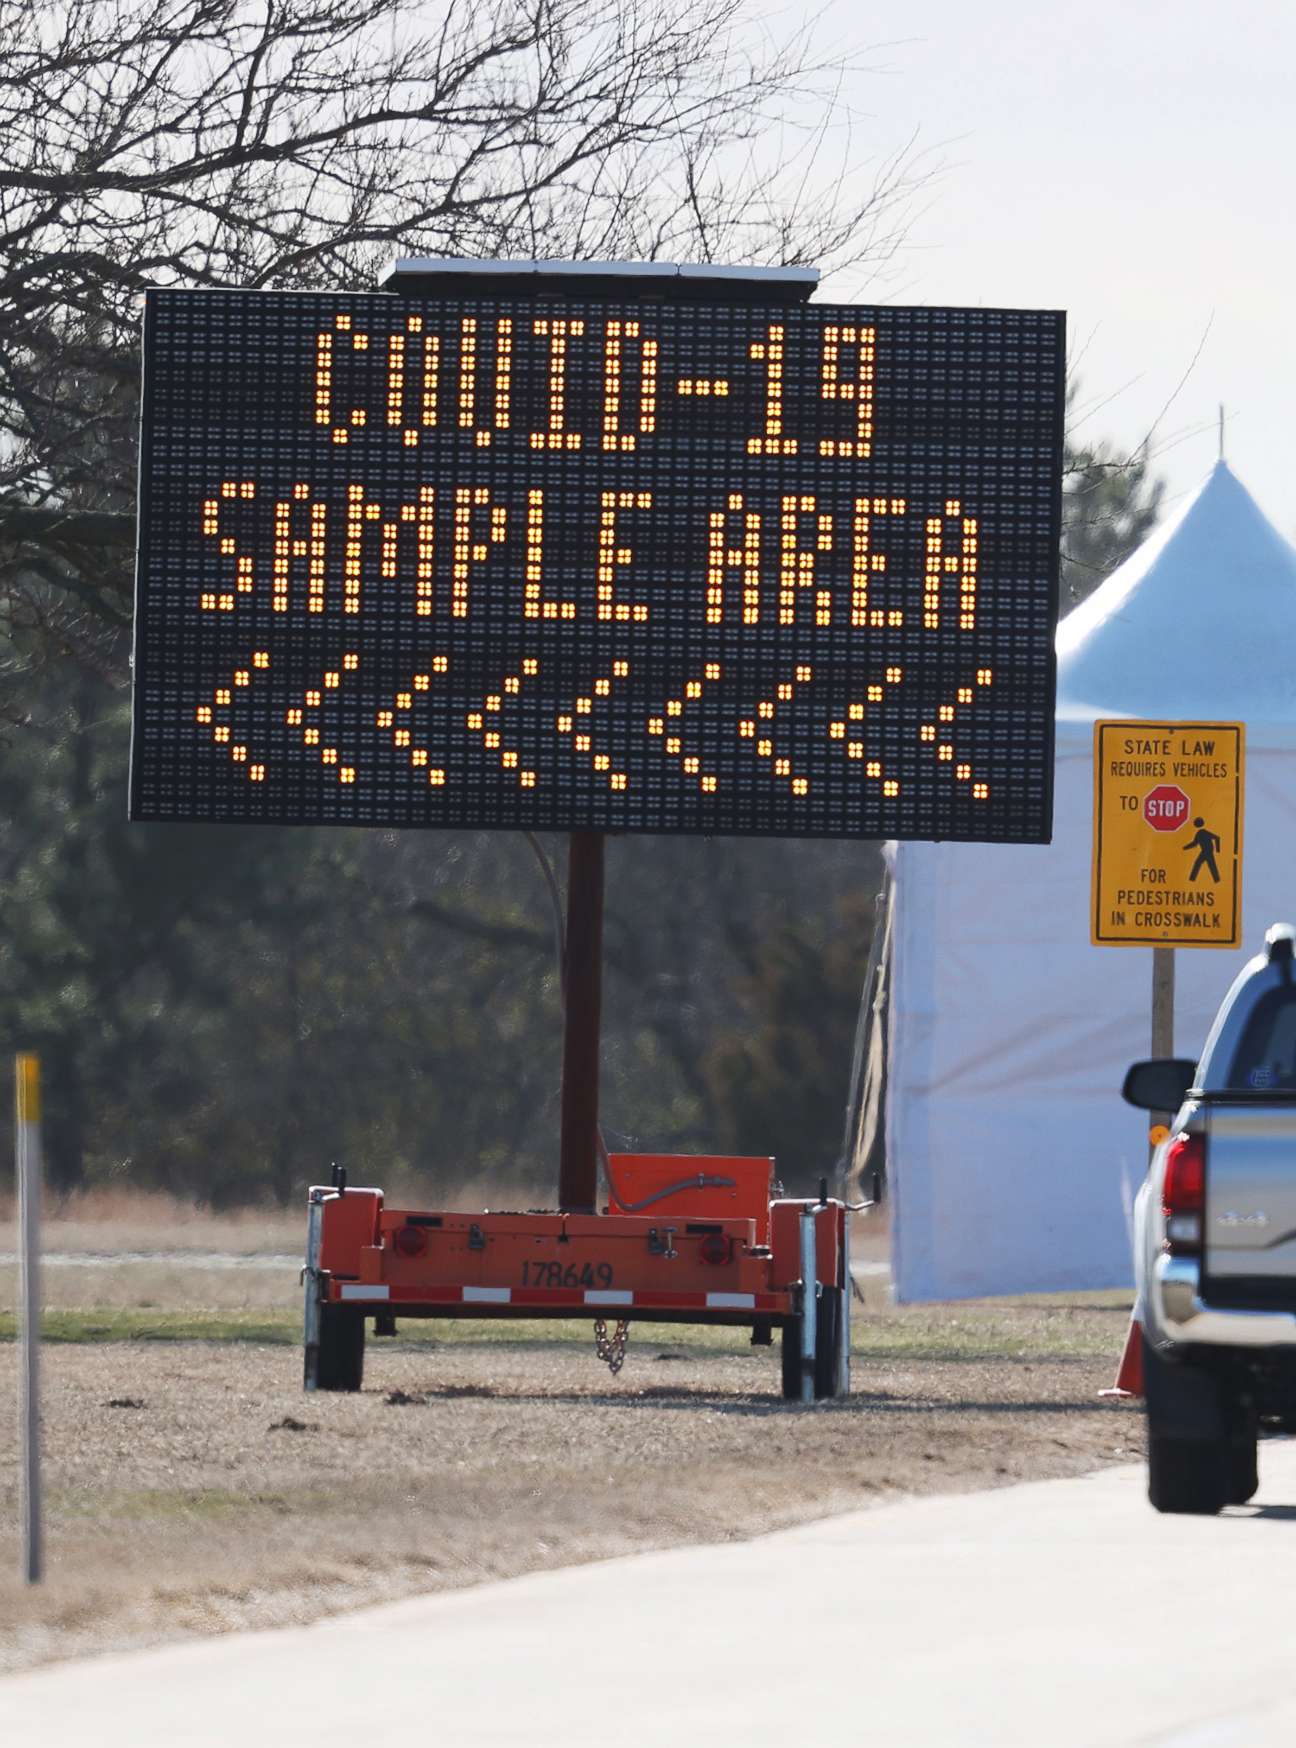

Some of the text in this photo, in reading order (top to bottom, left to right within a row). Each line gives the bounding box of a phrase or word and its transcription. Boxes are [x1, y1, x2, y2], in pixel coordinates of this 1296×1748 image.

[315, 315, 876, 459] COVID-19
[202, 483, 978, 631] SAMPLE AREA
[1124, 739, 1215, 756] STATE LAW
[1111, 761, 1228, 779] REQUIRES VEHICLES
[1120, 795, 1186, 817] TO STOP
[1141, 868, 1167, 884] FOR
[1117, 889, 1215, 907] PEDESTRIANS
[1112, 911, 1221, 928] IN CROSSWALK
[521, 1260, 613, 1289] 178649
